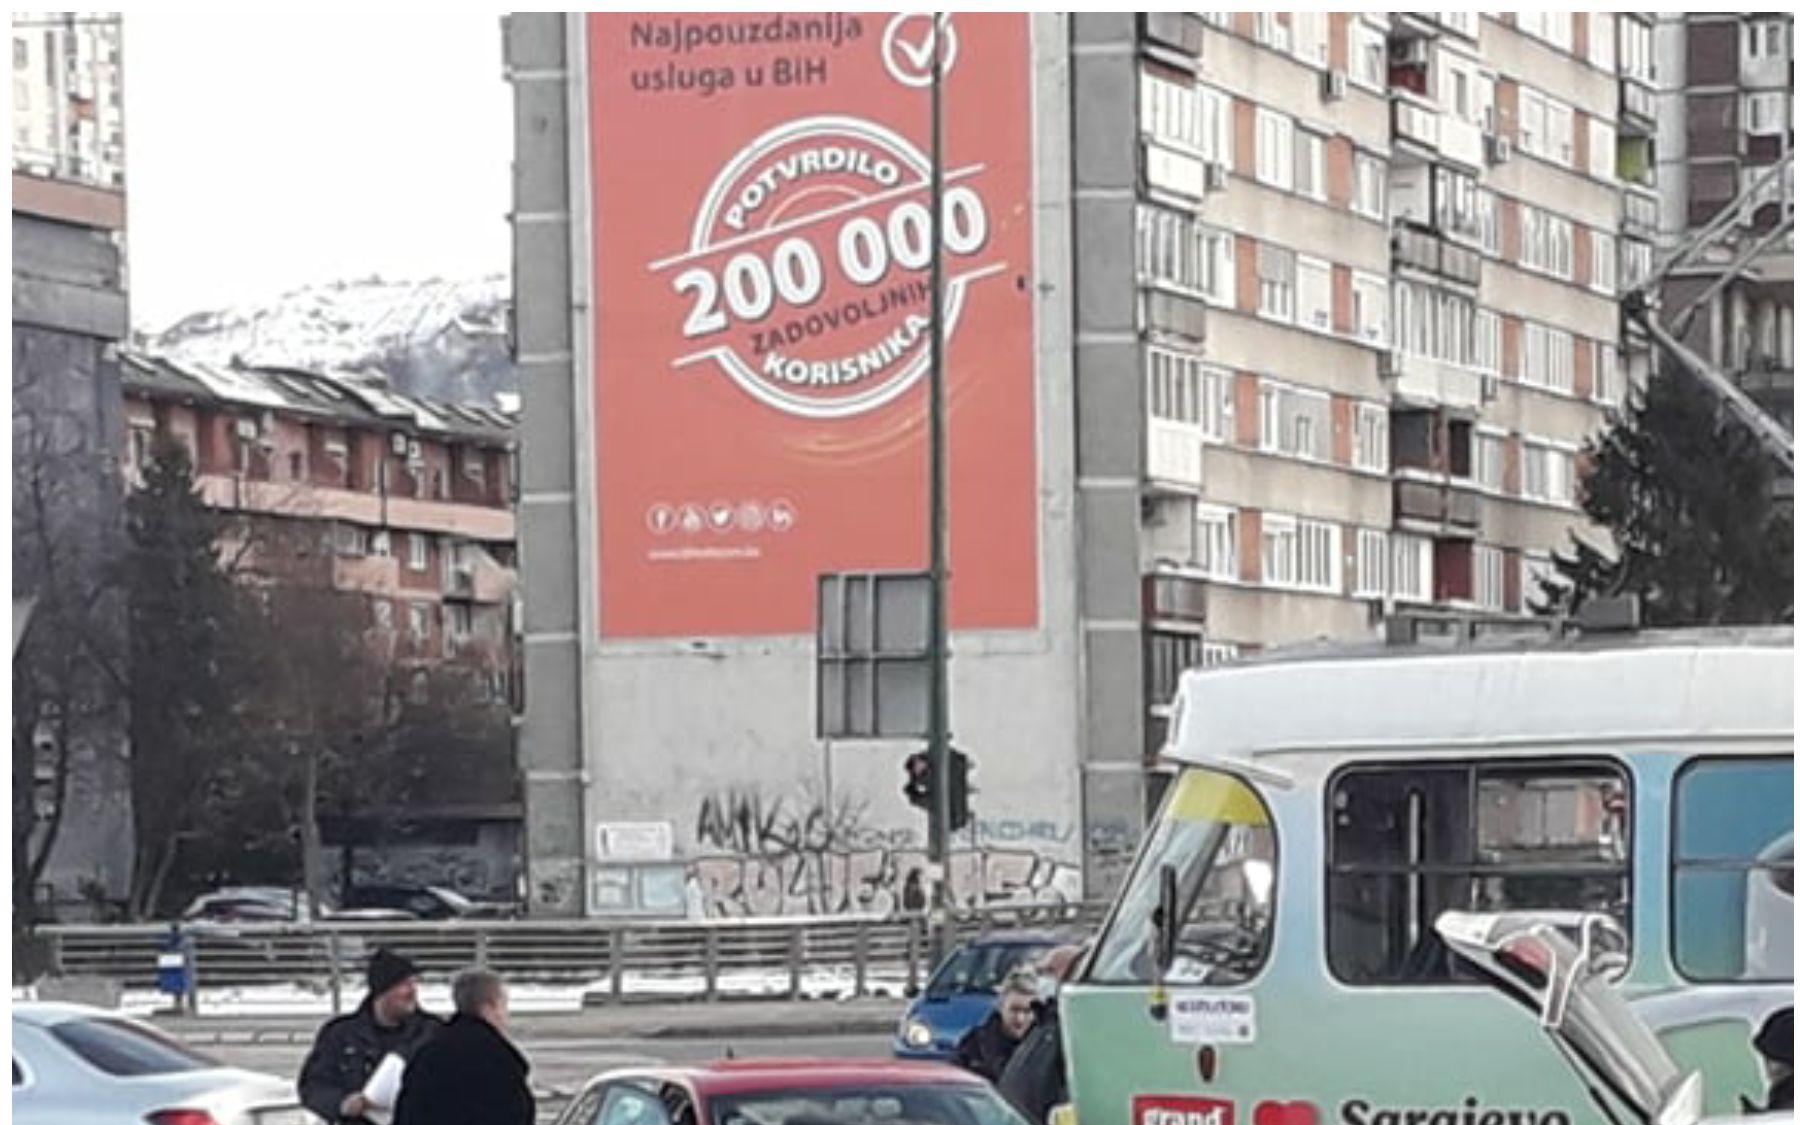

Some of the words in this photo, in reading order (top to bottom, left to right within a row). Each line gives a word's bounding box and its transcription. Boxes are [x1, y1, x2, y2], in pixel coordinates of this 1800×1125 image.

[631, 12, 862, 53] Najpouzdanija
[632, 61, 735, 97] usluga
[745, 67, 763, 87] u
[773, 56, 827, 87] BiH
[724, 146, 898, 229] POTVRDILO
[673, 237, 823, 337] 200
[837, 186, 988, 285] 000
[763, 314, 932, 385] KORISNIKA
